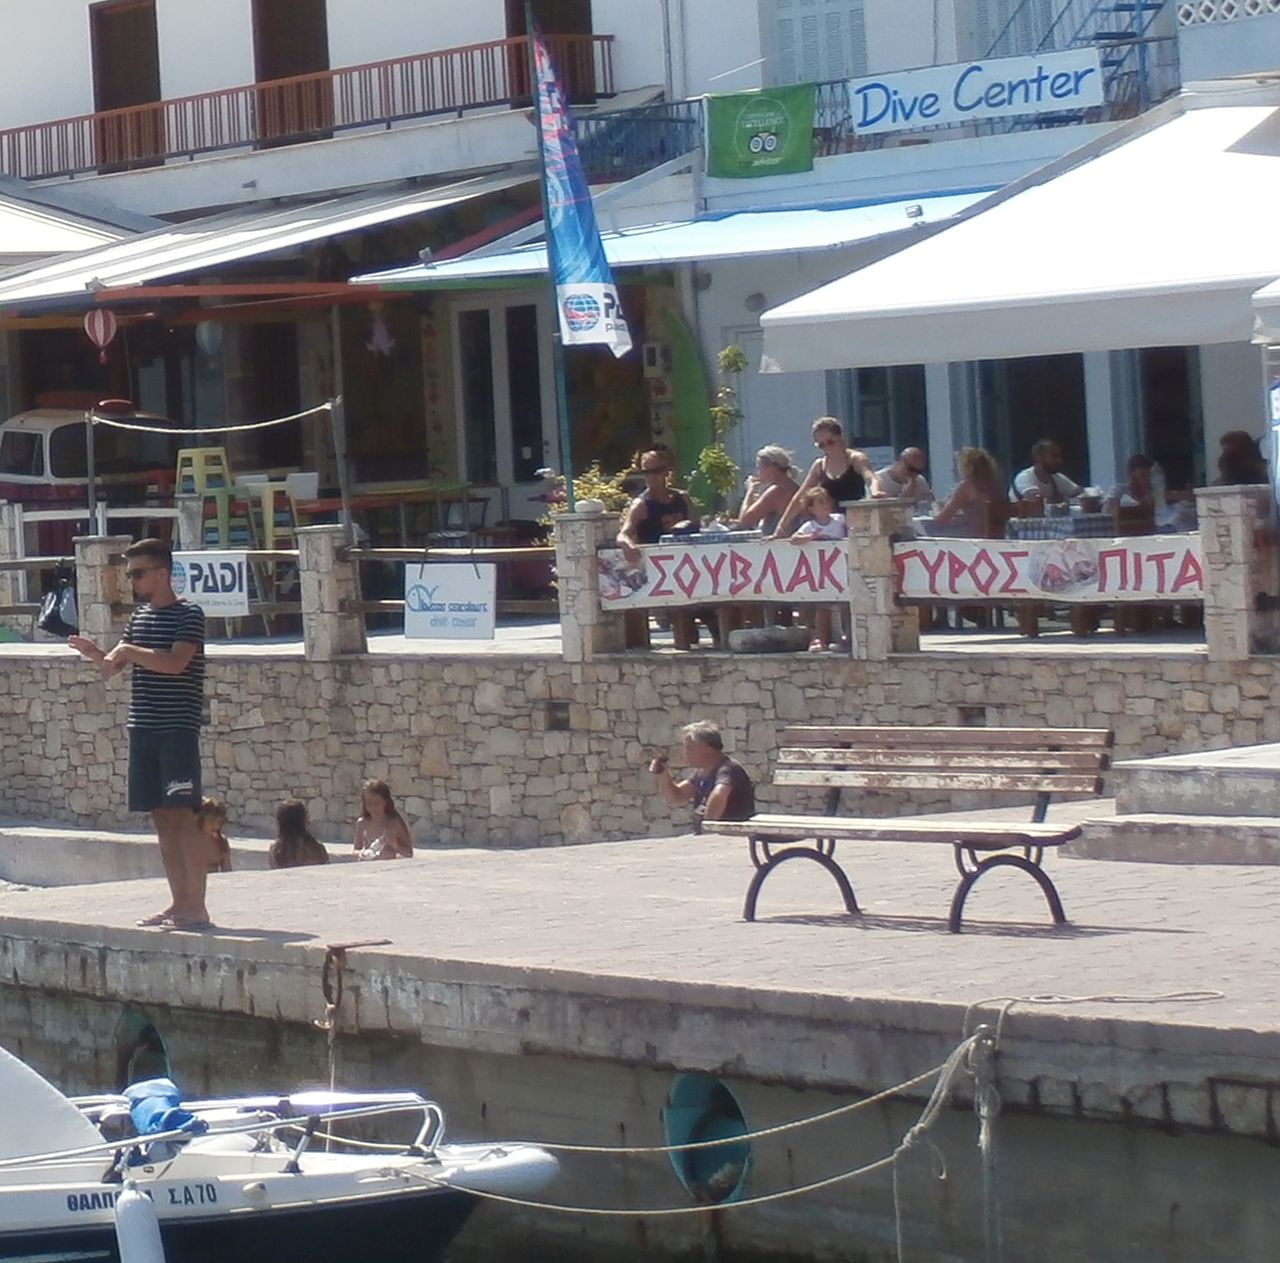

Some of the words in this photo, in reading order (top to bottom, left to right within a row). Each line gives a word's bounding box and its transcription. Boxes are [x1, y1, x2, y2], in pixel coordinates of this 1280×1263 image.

[855, 83, 940, 128] Dive
[953, 65, 1095, 111] Center
[189, 562, 243, 593] PADI
[894, 549, 1029, 595] ΓΥΡΟΣ
[1098, 548, 1204, 593] ΠΙΤΑ
